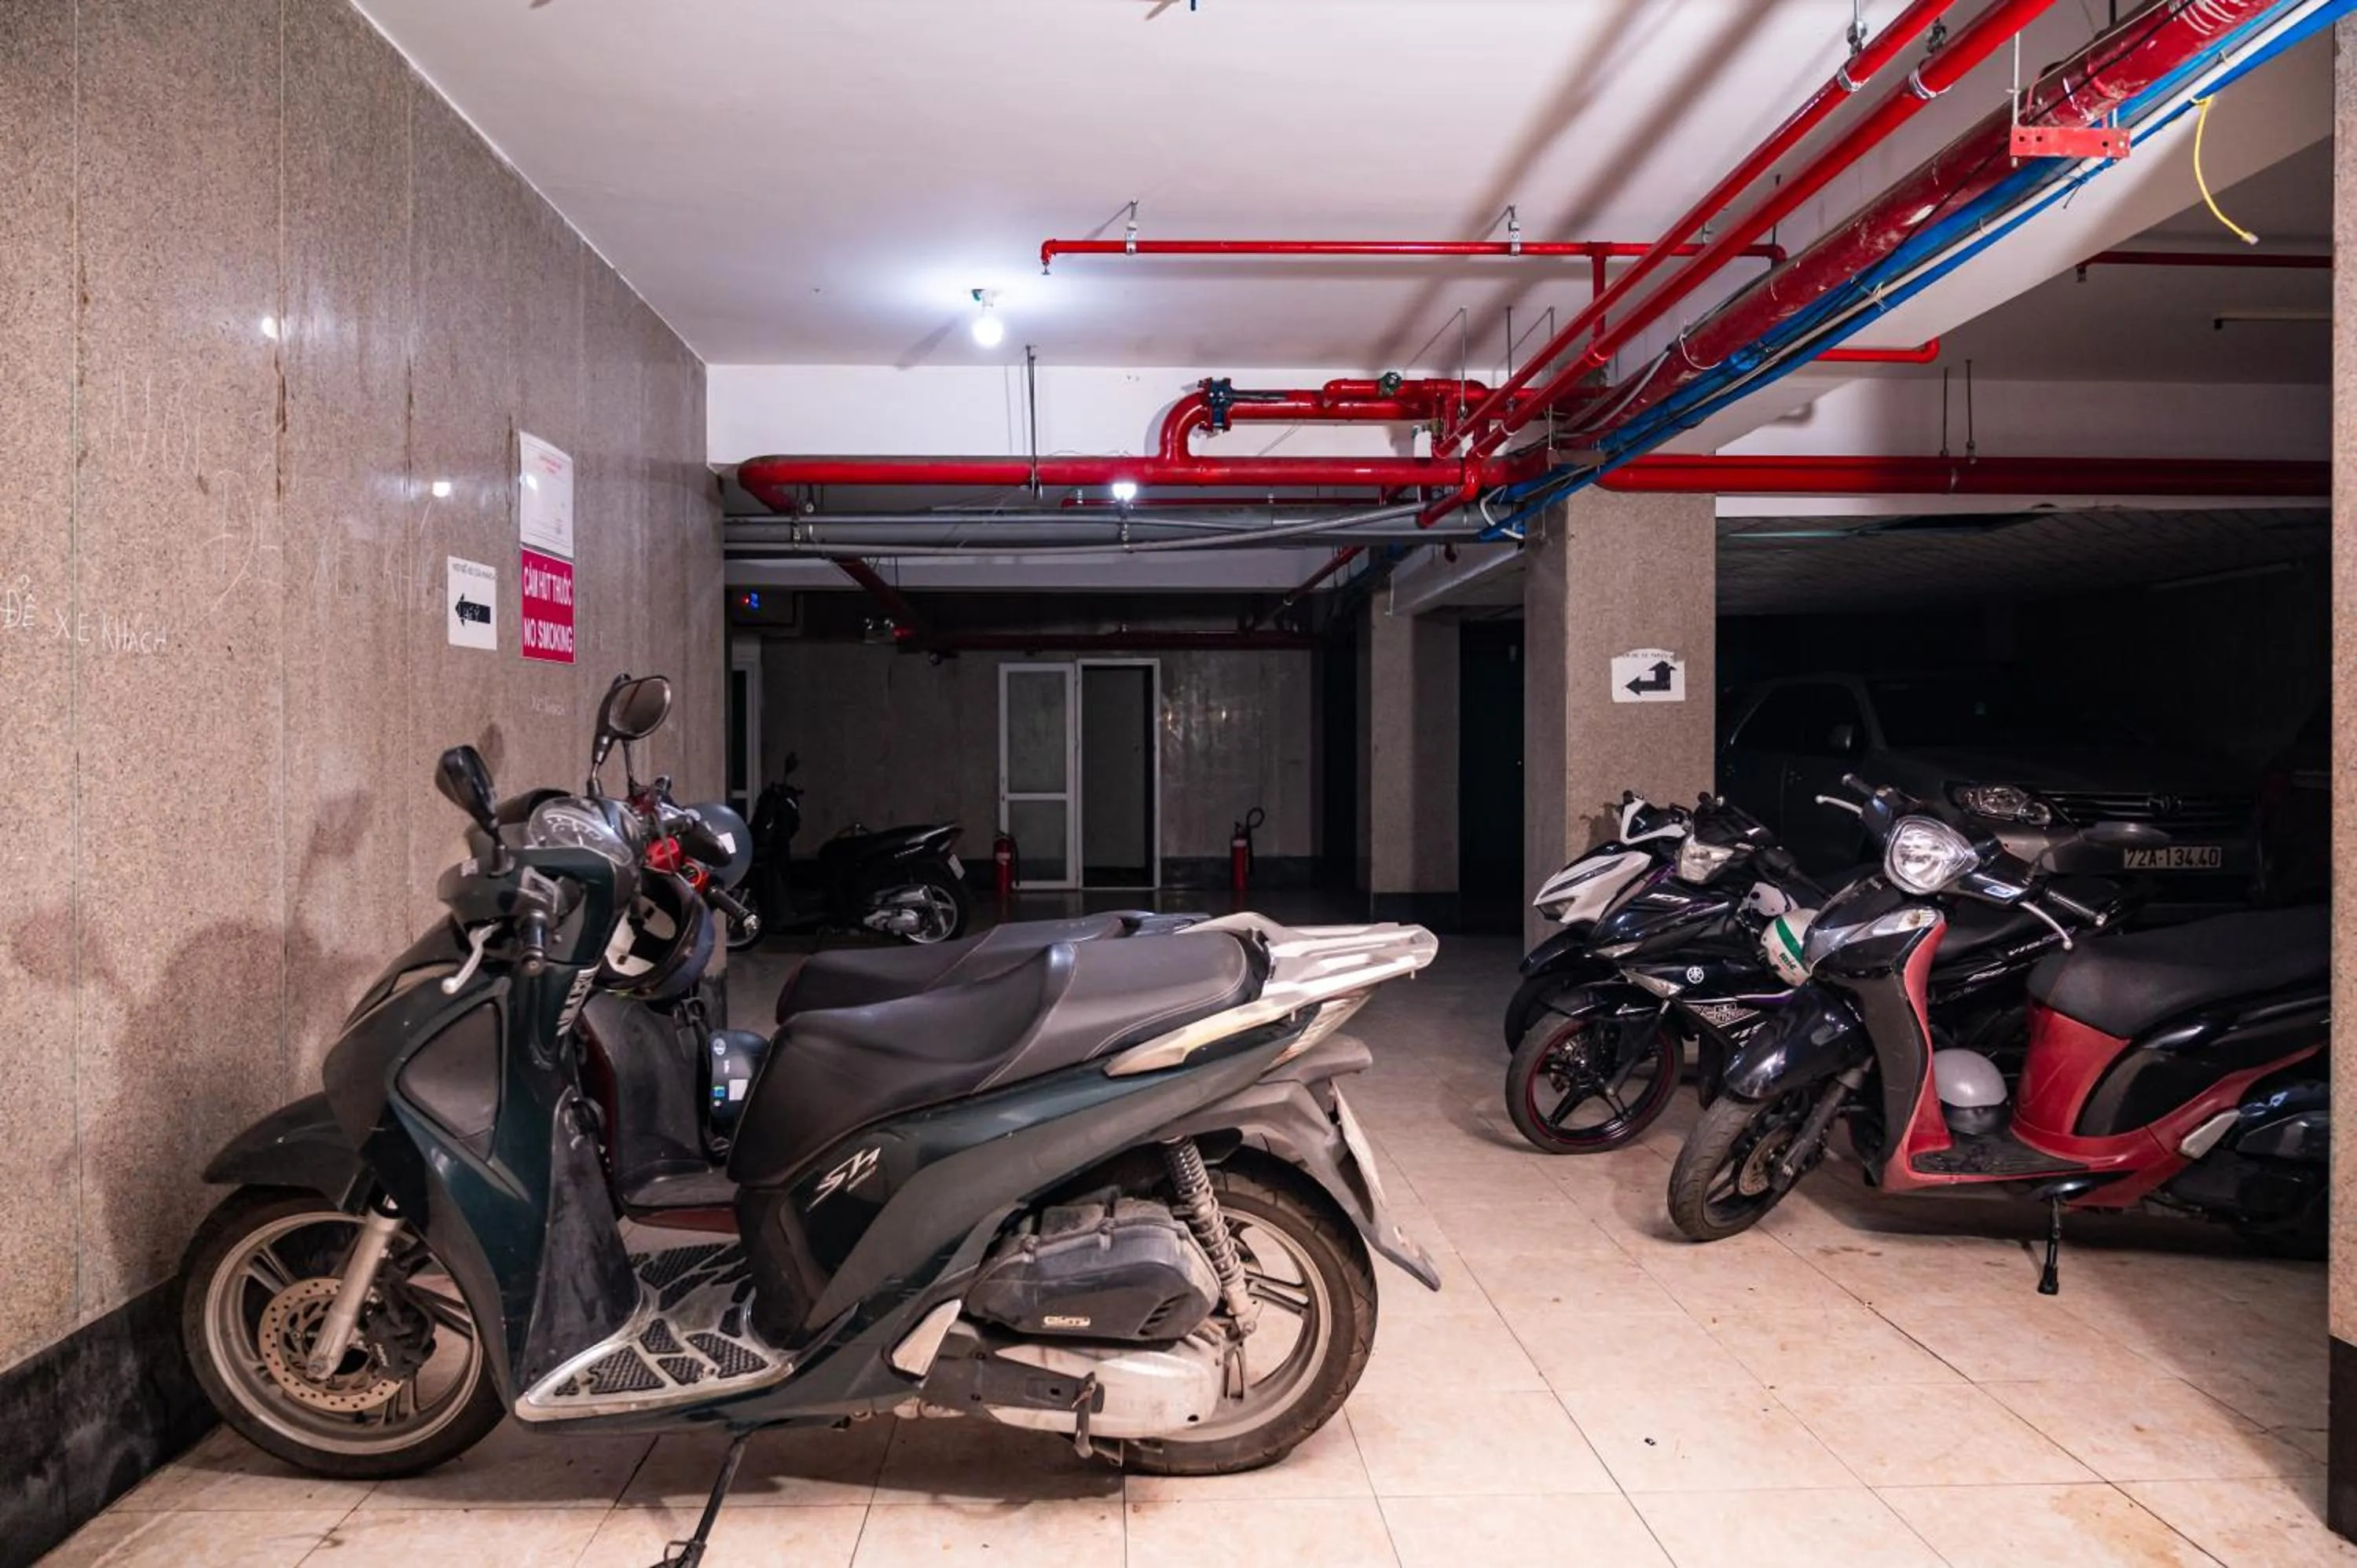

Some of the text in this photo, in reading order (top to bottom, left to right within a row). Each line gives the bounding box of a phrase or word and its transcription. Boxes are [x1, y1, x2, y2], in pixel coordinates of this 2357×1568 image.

[52, 607, 91, 643] XE
[524, 617, 572, 654] NO SMOKING
